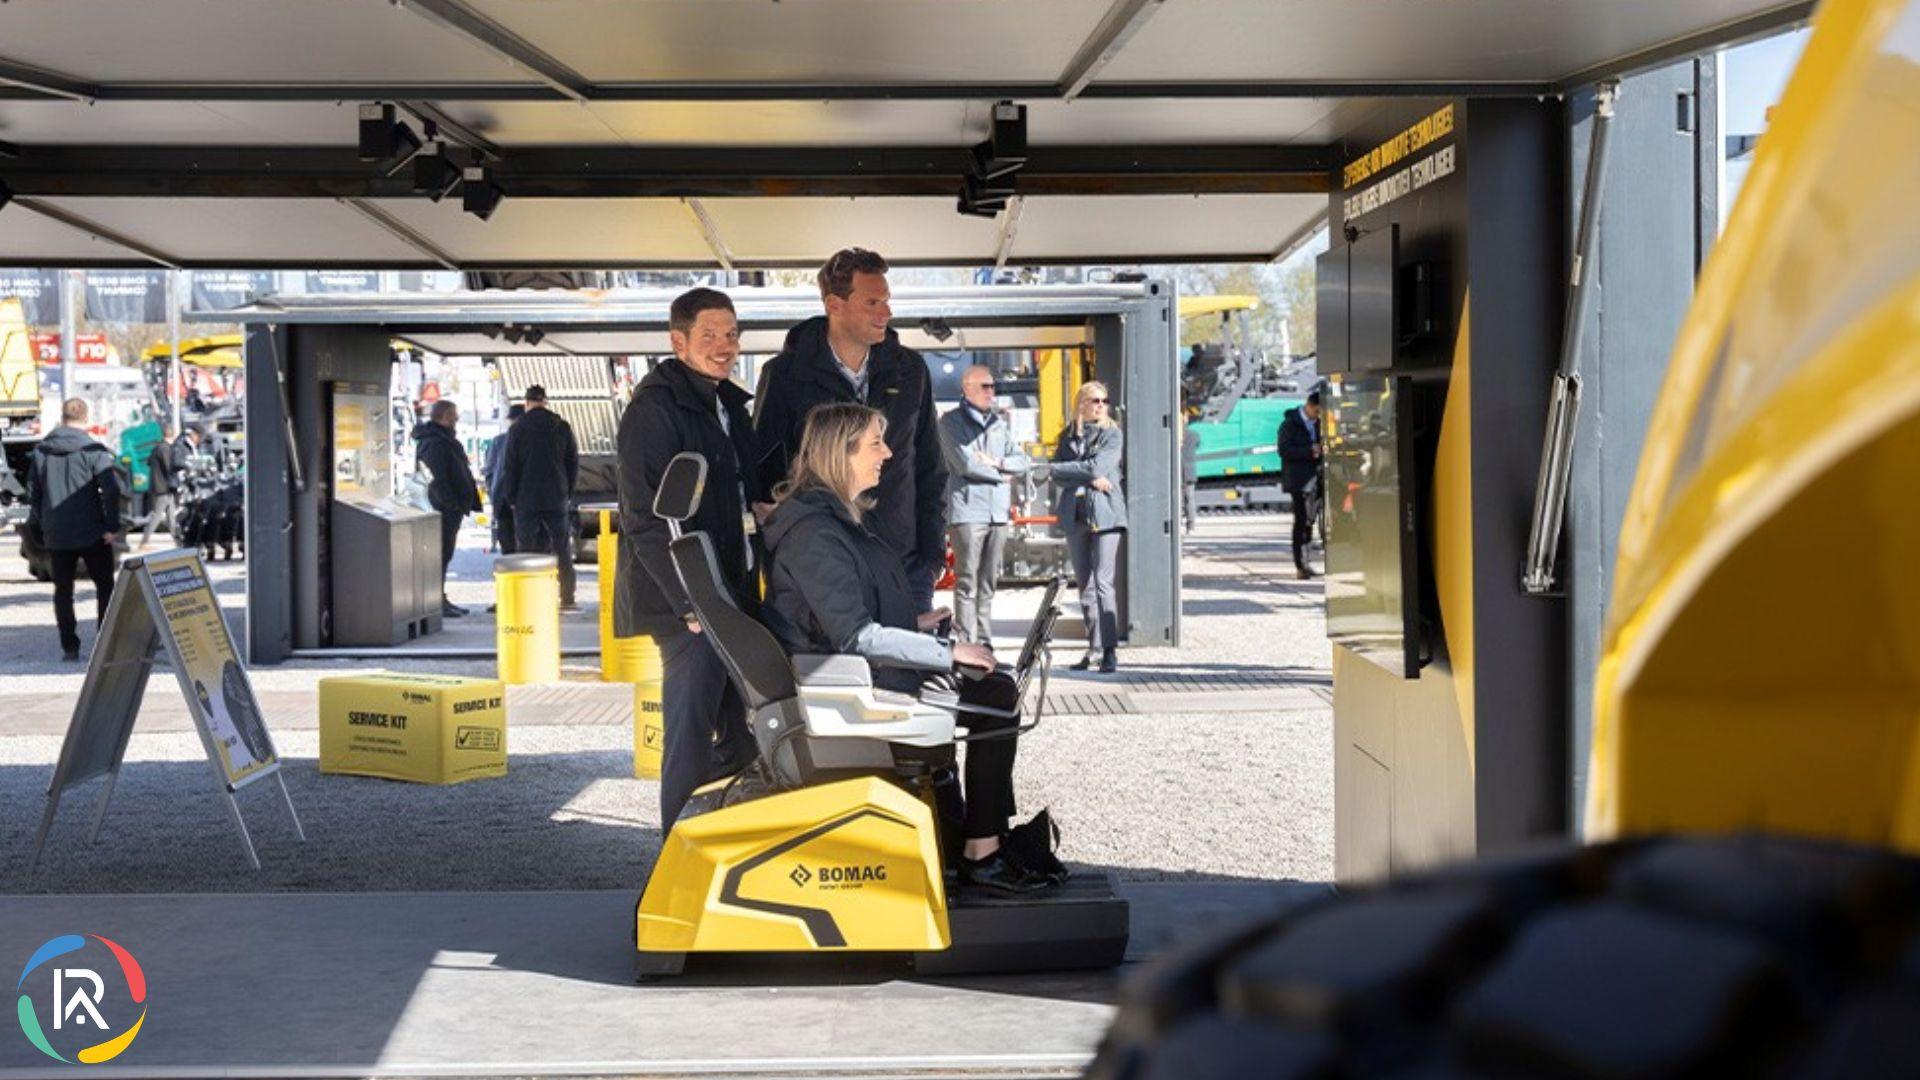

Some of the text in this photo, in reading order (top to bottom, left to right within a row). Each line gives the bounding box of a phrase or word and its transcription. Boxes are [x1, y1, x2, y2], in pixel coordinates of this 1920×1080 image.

[453, 697, 502, 714] SERVICE KIT
[348, 711, 408, 730] SERVICE KIT
[818, 865, 887, 882] BOMAG
